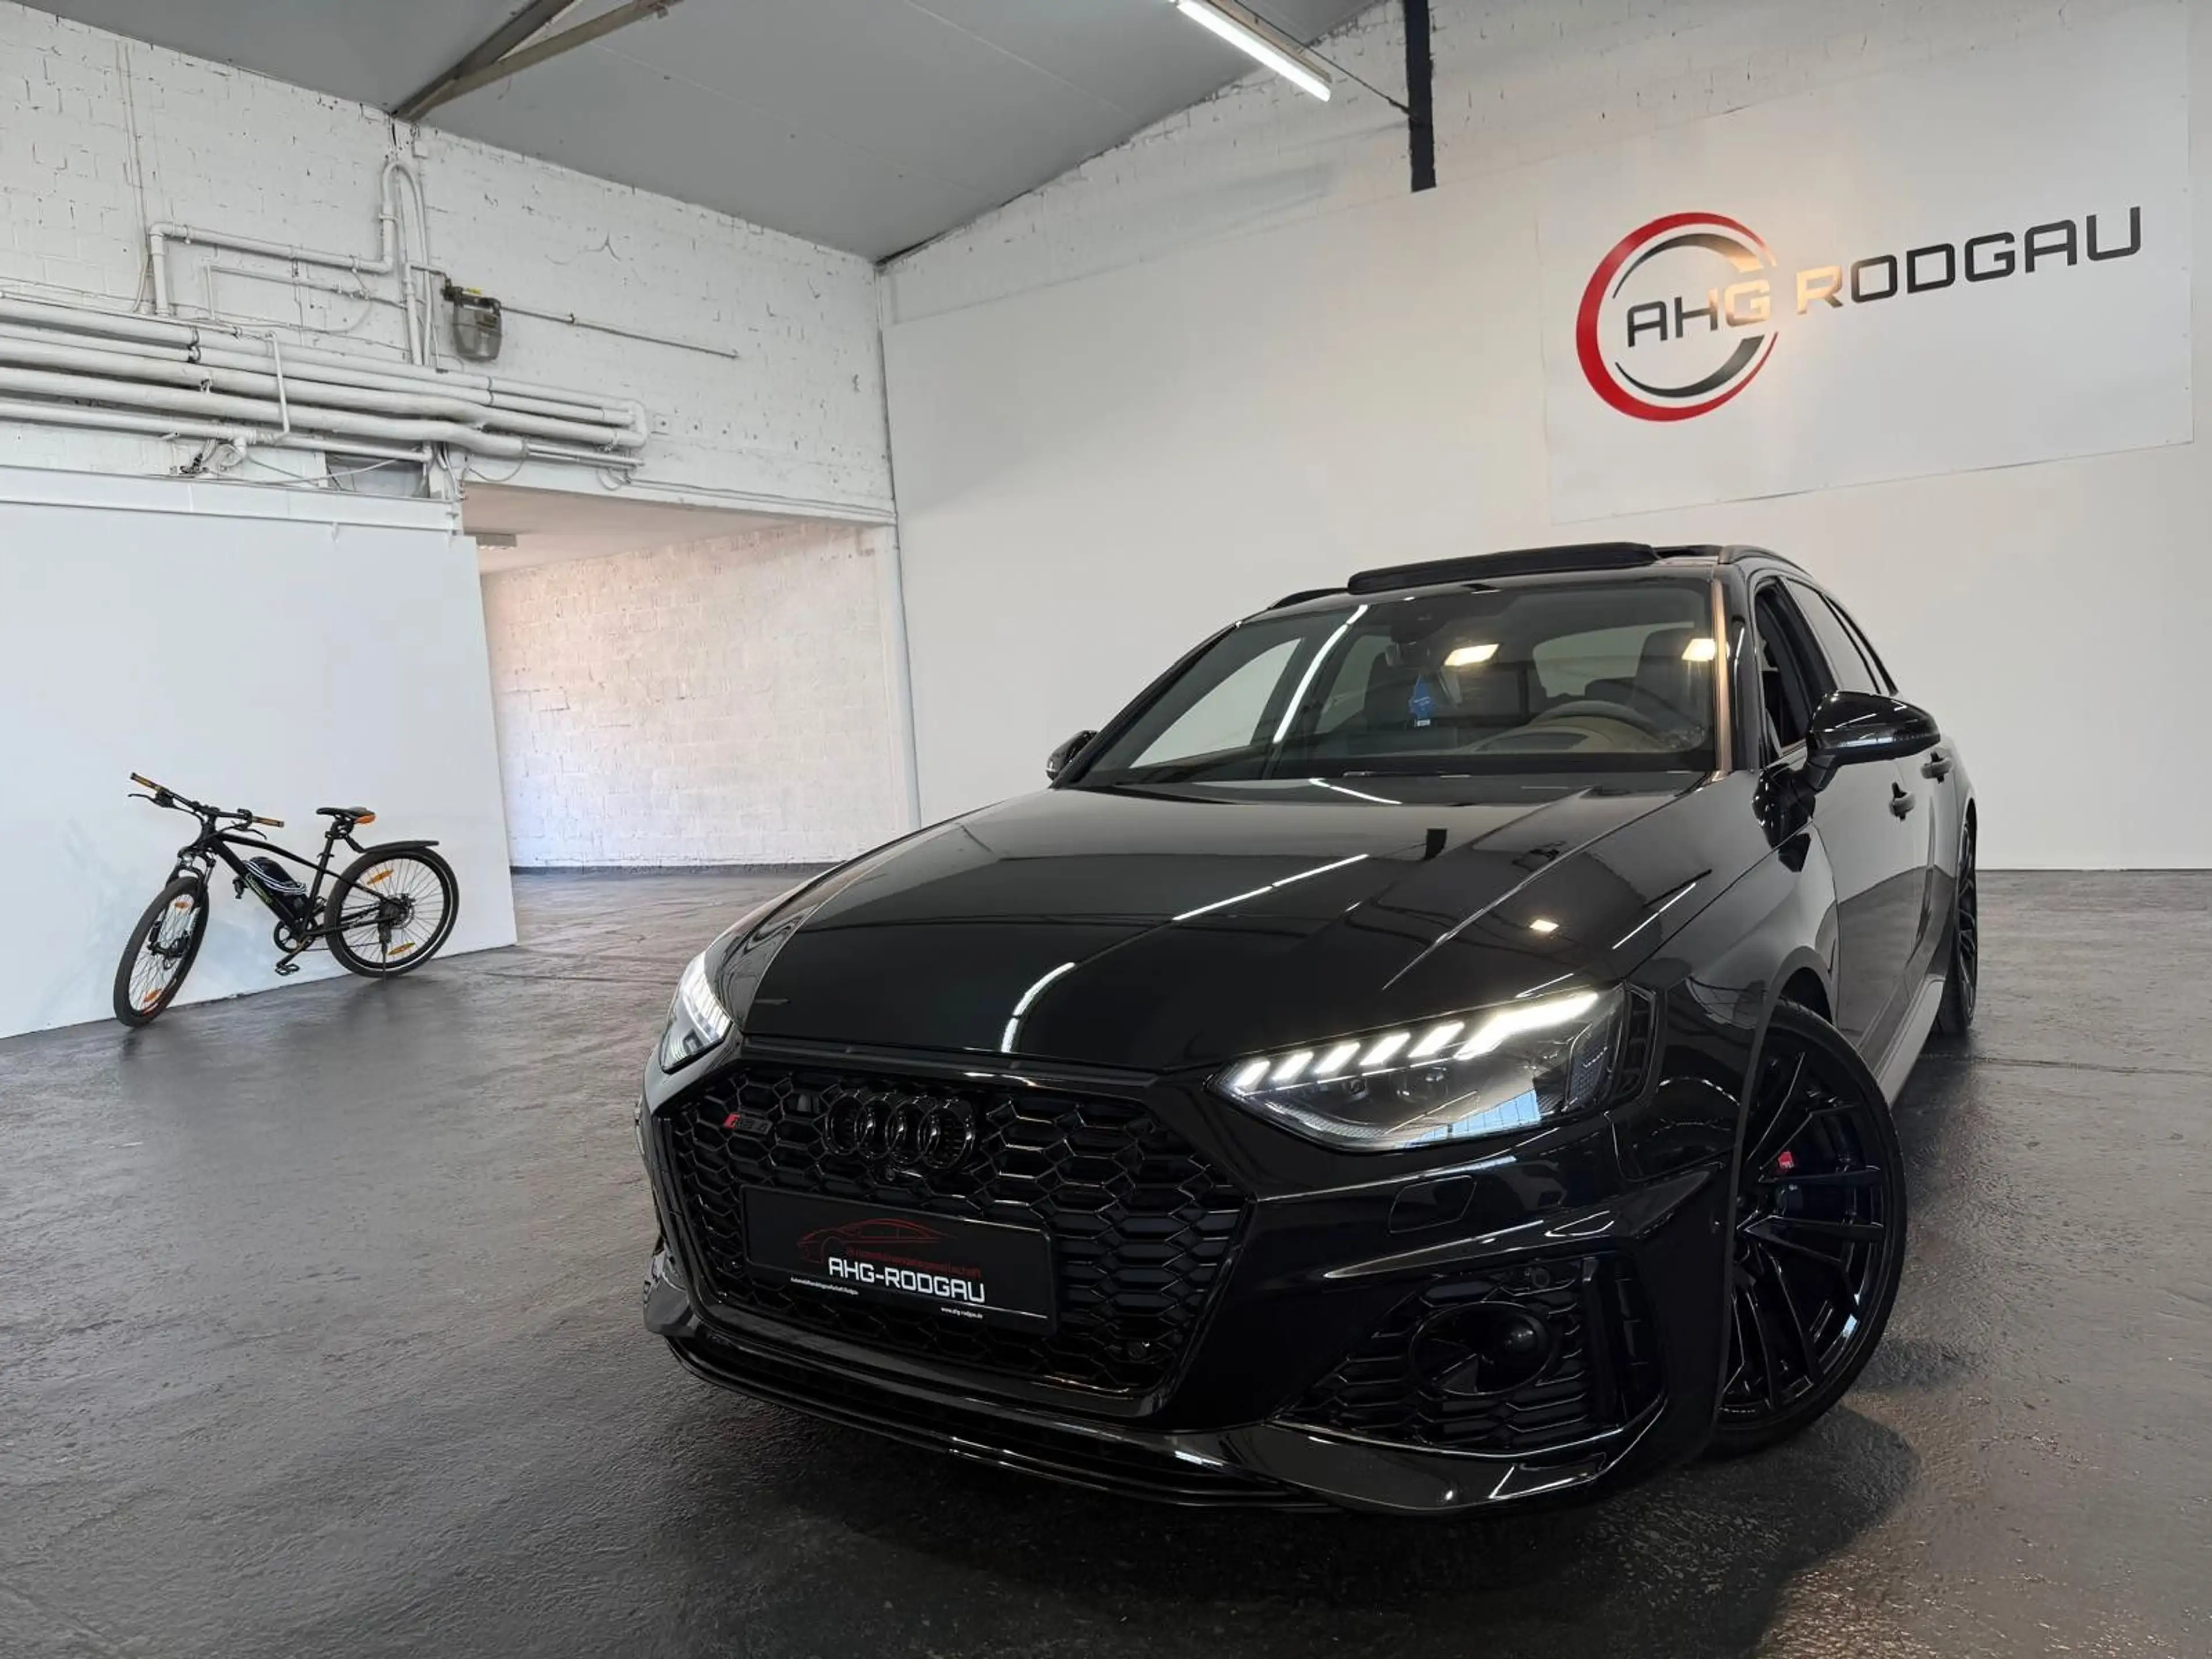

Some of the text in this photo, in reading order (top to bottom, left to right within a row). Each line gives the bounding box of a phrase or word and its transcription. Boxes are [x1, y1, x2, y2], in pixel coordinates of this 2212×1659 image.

[1626, 206, 2142, 348] AHG RODGAU
[828, 1256, 986, 1304] AHG-RODGAU
